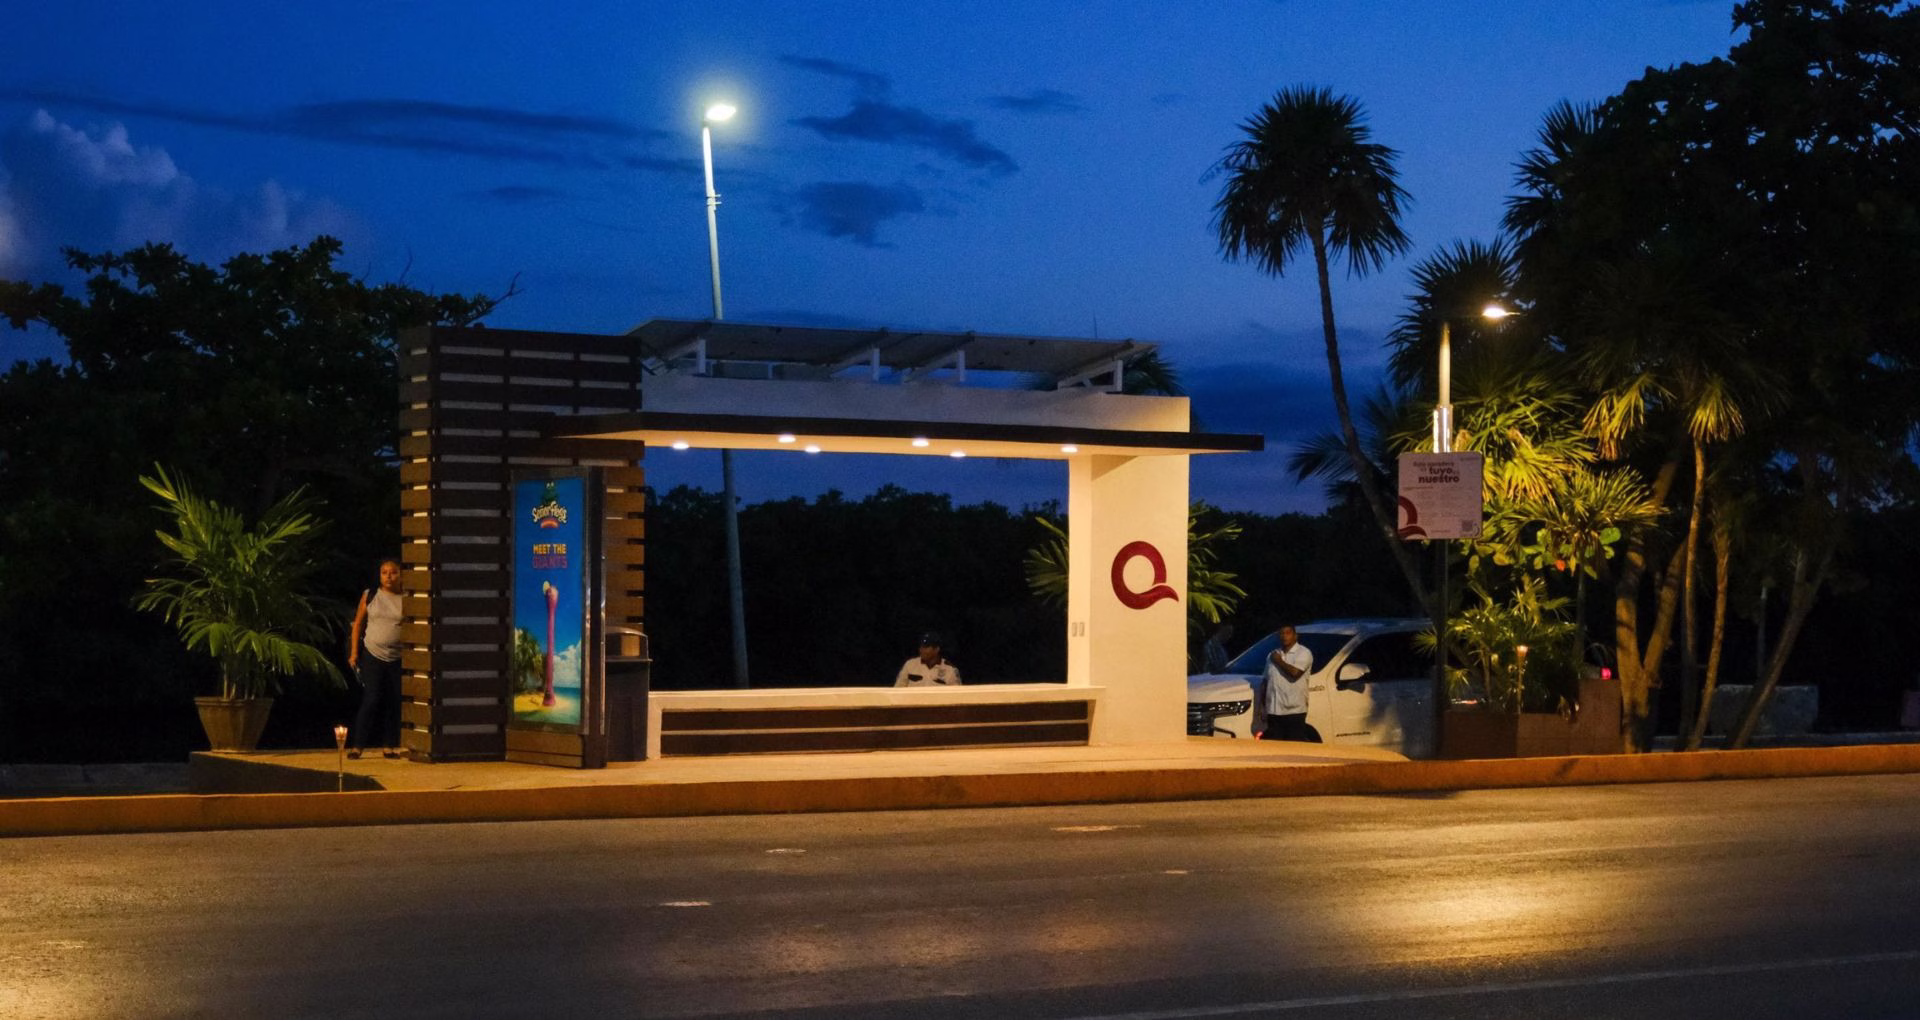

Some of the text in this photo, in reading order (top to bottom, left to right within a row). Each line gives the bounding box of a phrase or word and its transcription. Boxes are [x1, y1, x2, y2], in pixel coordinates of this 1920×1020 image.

[1418, 475, 1460, 484] nuestro
[533, 543, 567, 554] MEET THE
[533, 555, 568, 569] GIANTS
